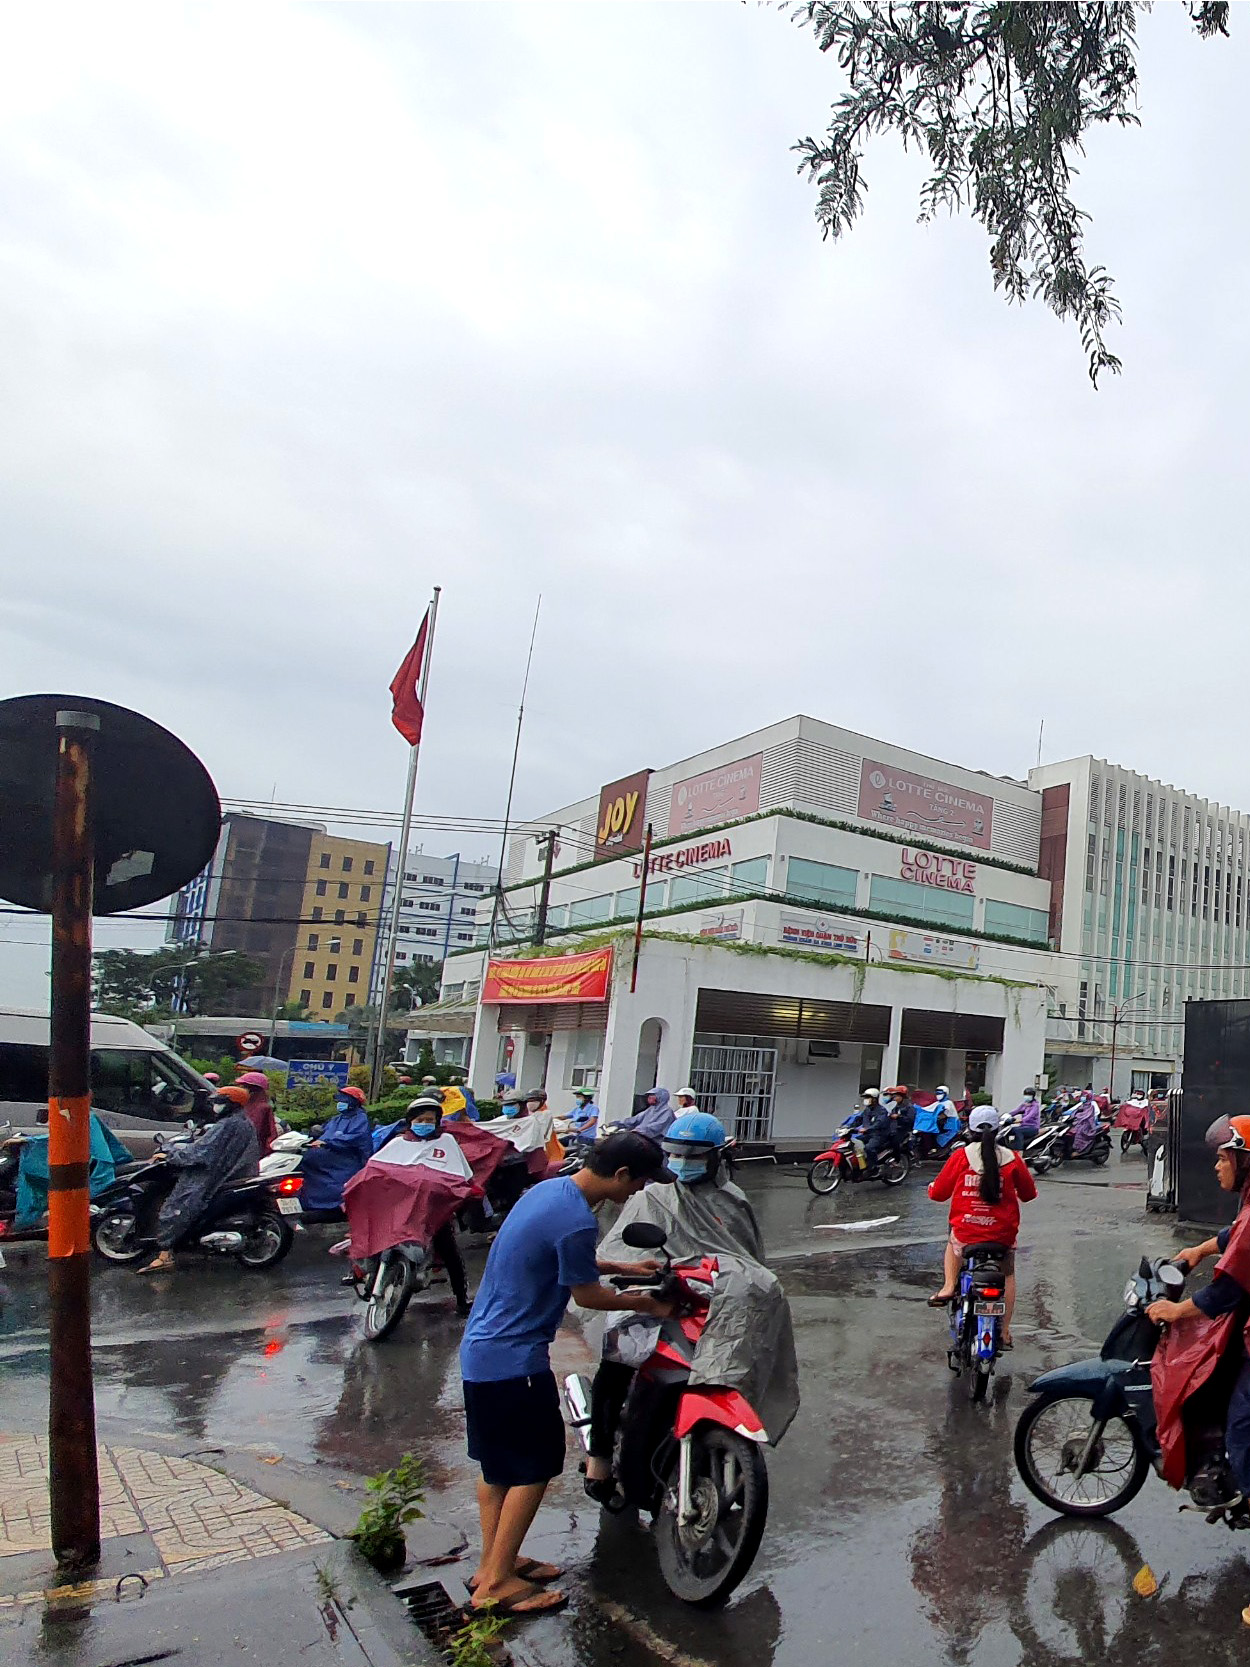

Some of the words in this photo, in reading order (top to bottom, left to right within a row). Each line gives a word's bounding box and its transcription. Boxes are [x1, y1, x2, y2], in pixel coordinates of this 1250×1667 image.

[888, 778, 932, 800] LOTTE
[934, 791, 985, 815] CINEMA
[597, 790, 639, 845] JOY
[674, 838, 732, 869] CINEMA
[901, 847, 977, 880] LOTTE
[900, 865, 975, 894] CINEMA
